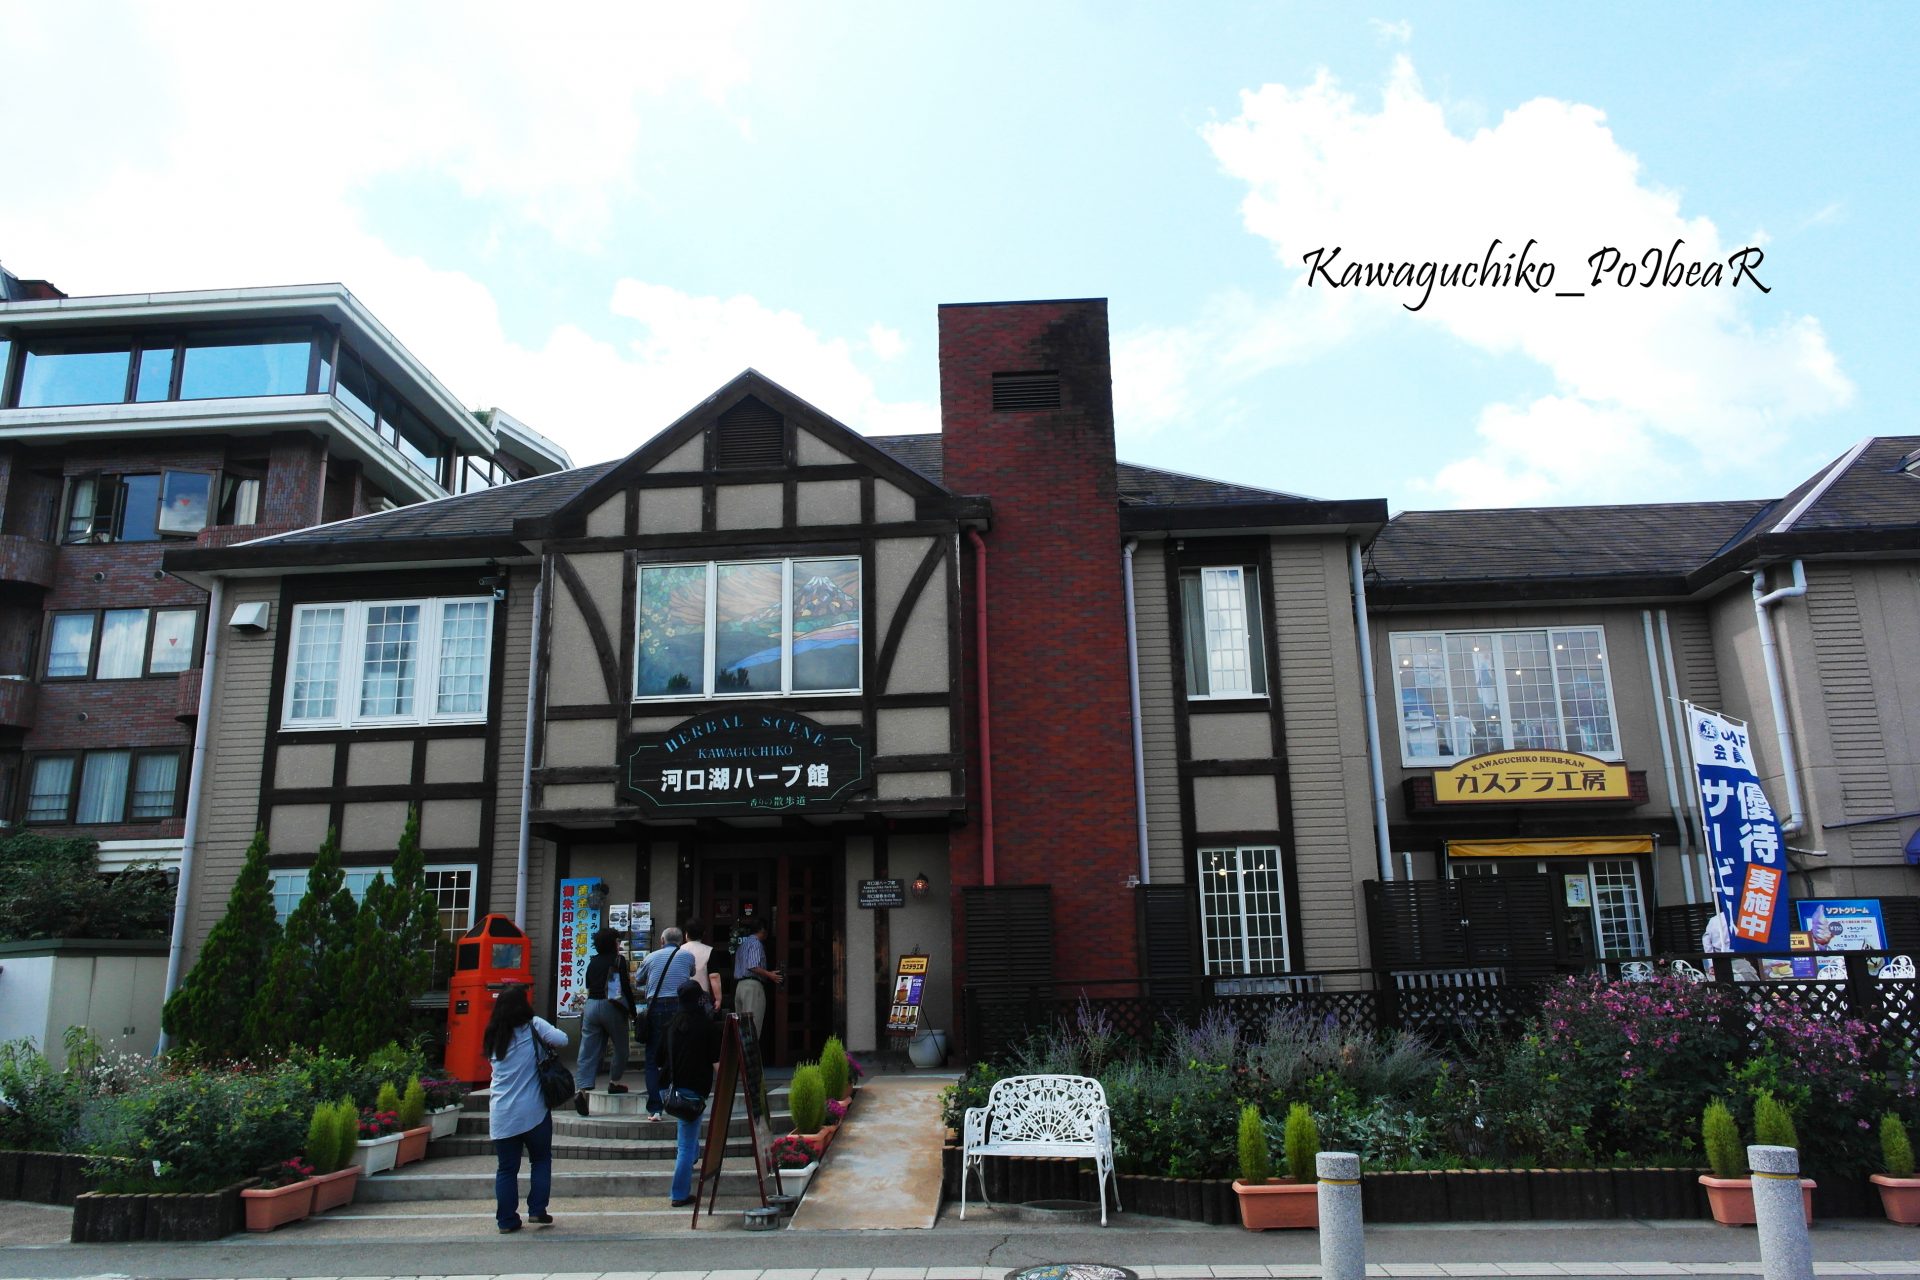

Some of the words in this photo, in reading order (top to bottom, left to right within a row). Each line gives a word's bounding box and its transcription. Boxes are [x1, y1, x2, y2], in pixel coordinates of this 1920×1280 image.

[664, 714, 744, 753] HERBAL
[761, 716, 827, 747] SCENE
[697, 744, 793, 759] KAWAGUCHIKO
[1471, 755, 1538, 772] KAWAGUCHIKO
[1539, 755, 1585, 769] HERB-KAN
[1714, 744, 1746, 765] 会員
[660, 763, 830, 793] 河口湖ハーブ館
[1455, 769, 1607, 794] カステラ工房
[1737, 780, 1779, 864] 優待
[1701, 778, 1740, 938] サービス
[1740, 868, 1777, 937] 実施中
[1825, 906, 1870, 915] ソフトクリーム
